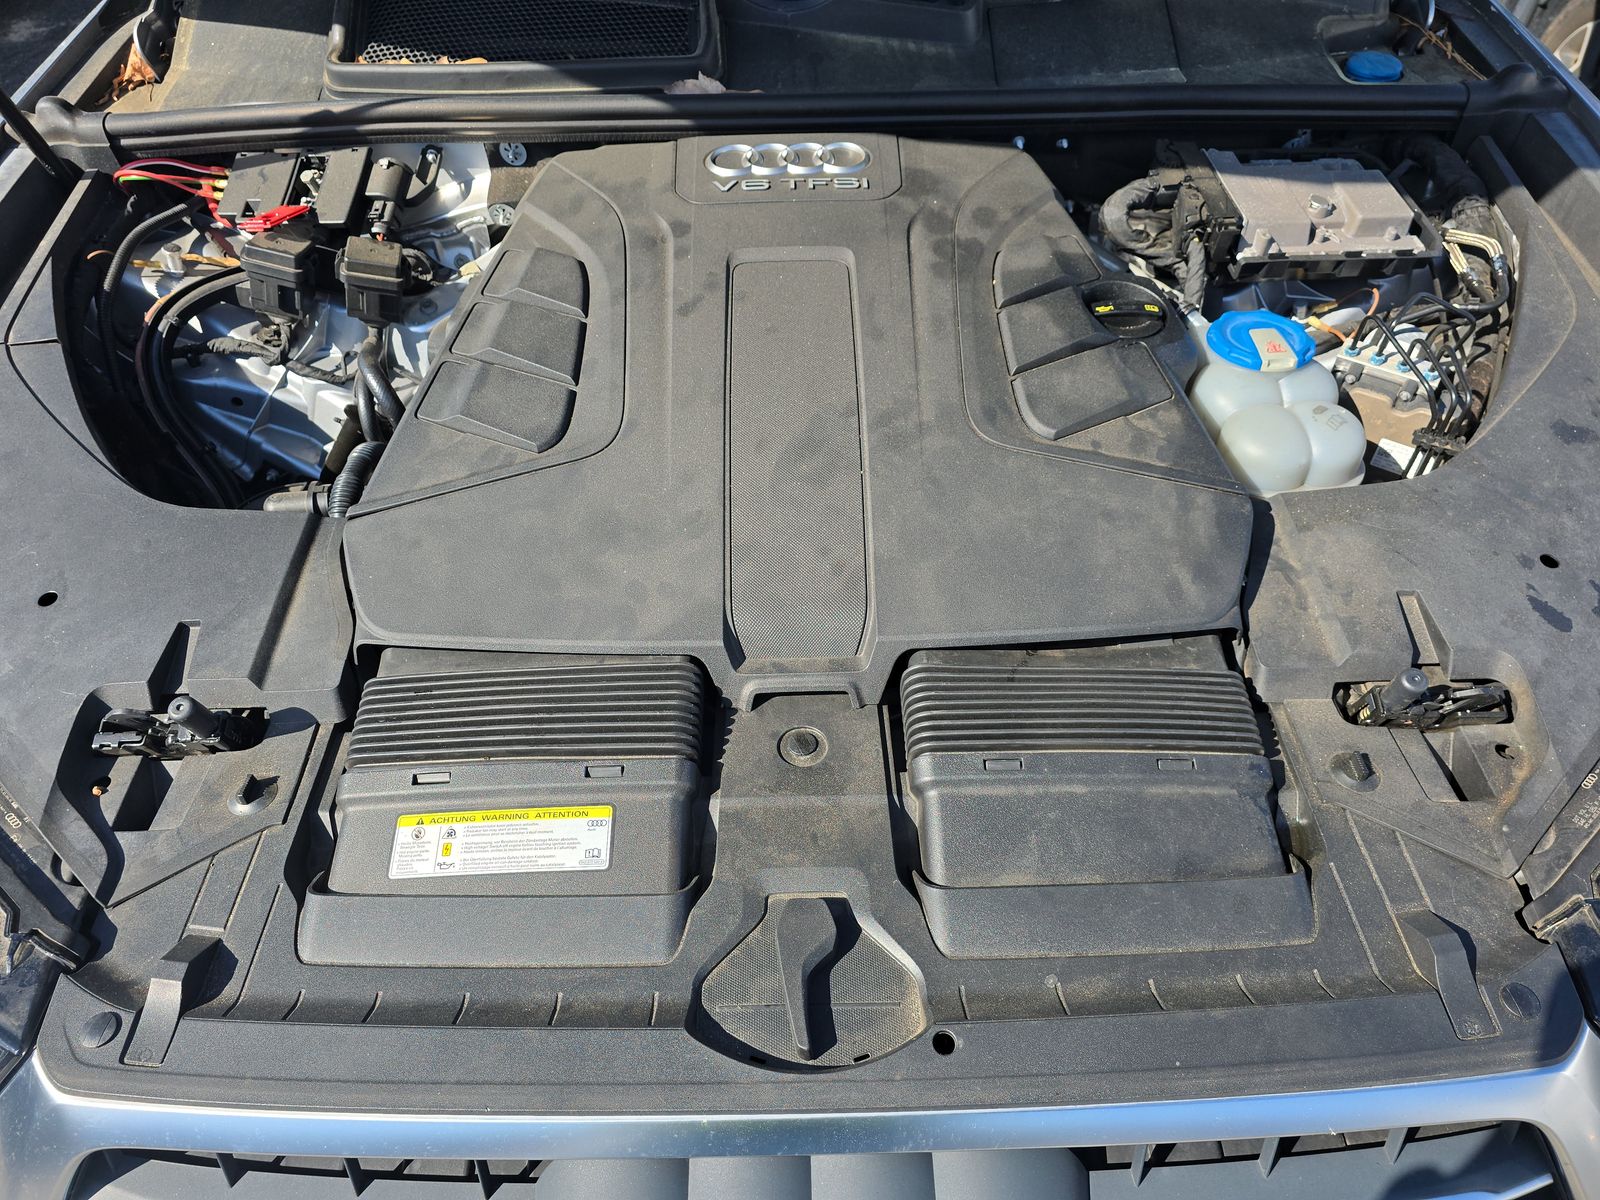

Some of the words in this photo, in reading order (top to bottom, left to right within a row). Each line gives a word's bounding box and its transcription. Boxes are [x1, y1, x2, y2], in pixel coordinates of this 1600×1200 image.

[712, 178, 771, 192] V6
[780, 177, 870, 190] TFSI
[429, 815, 476, 824] ACHTUNG
[481, 812, 530, 821] WARNING
[534, 810, 589, 819] ATTENTION
